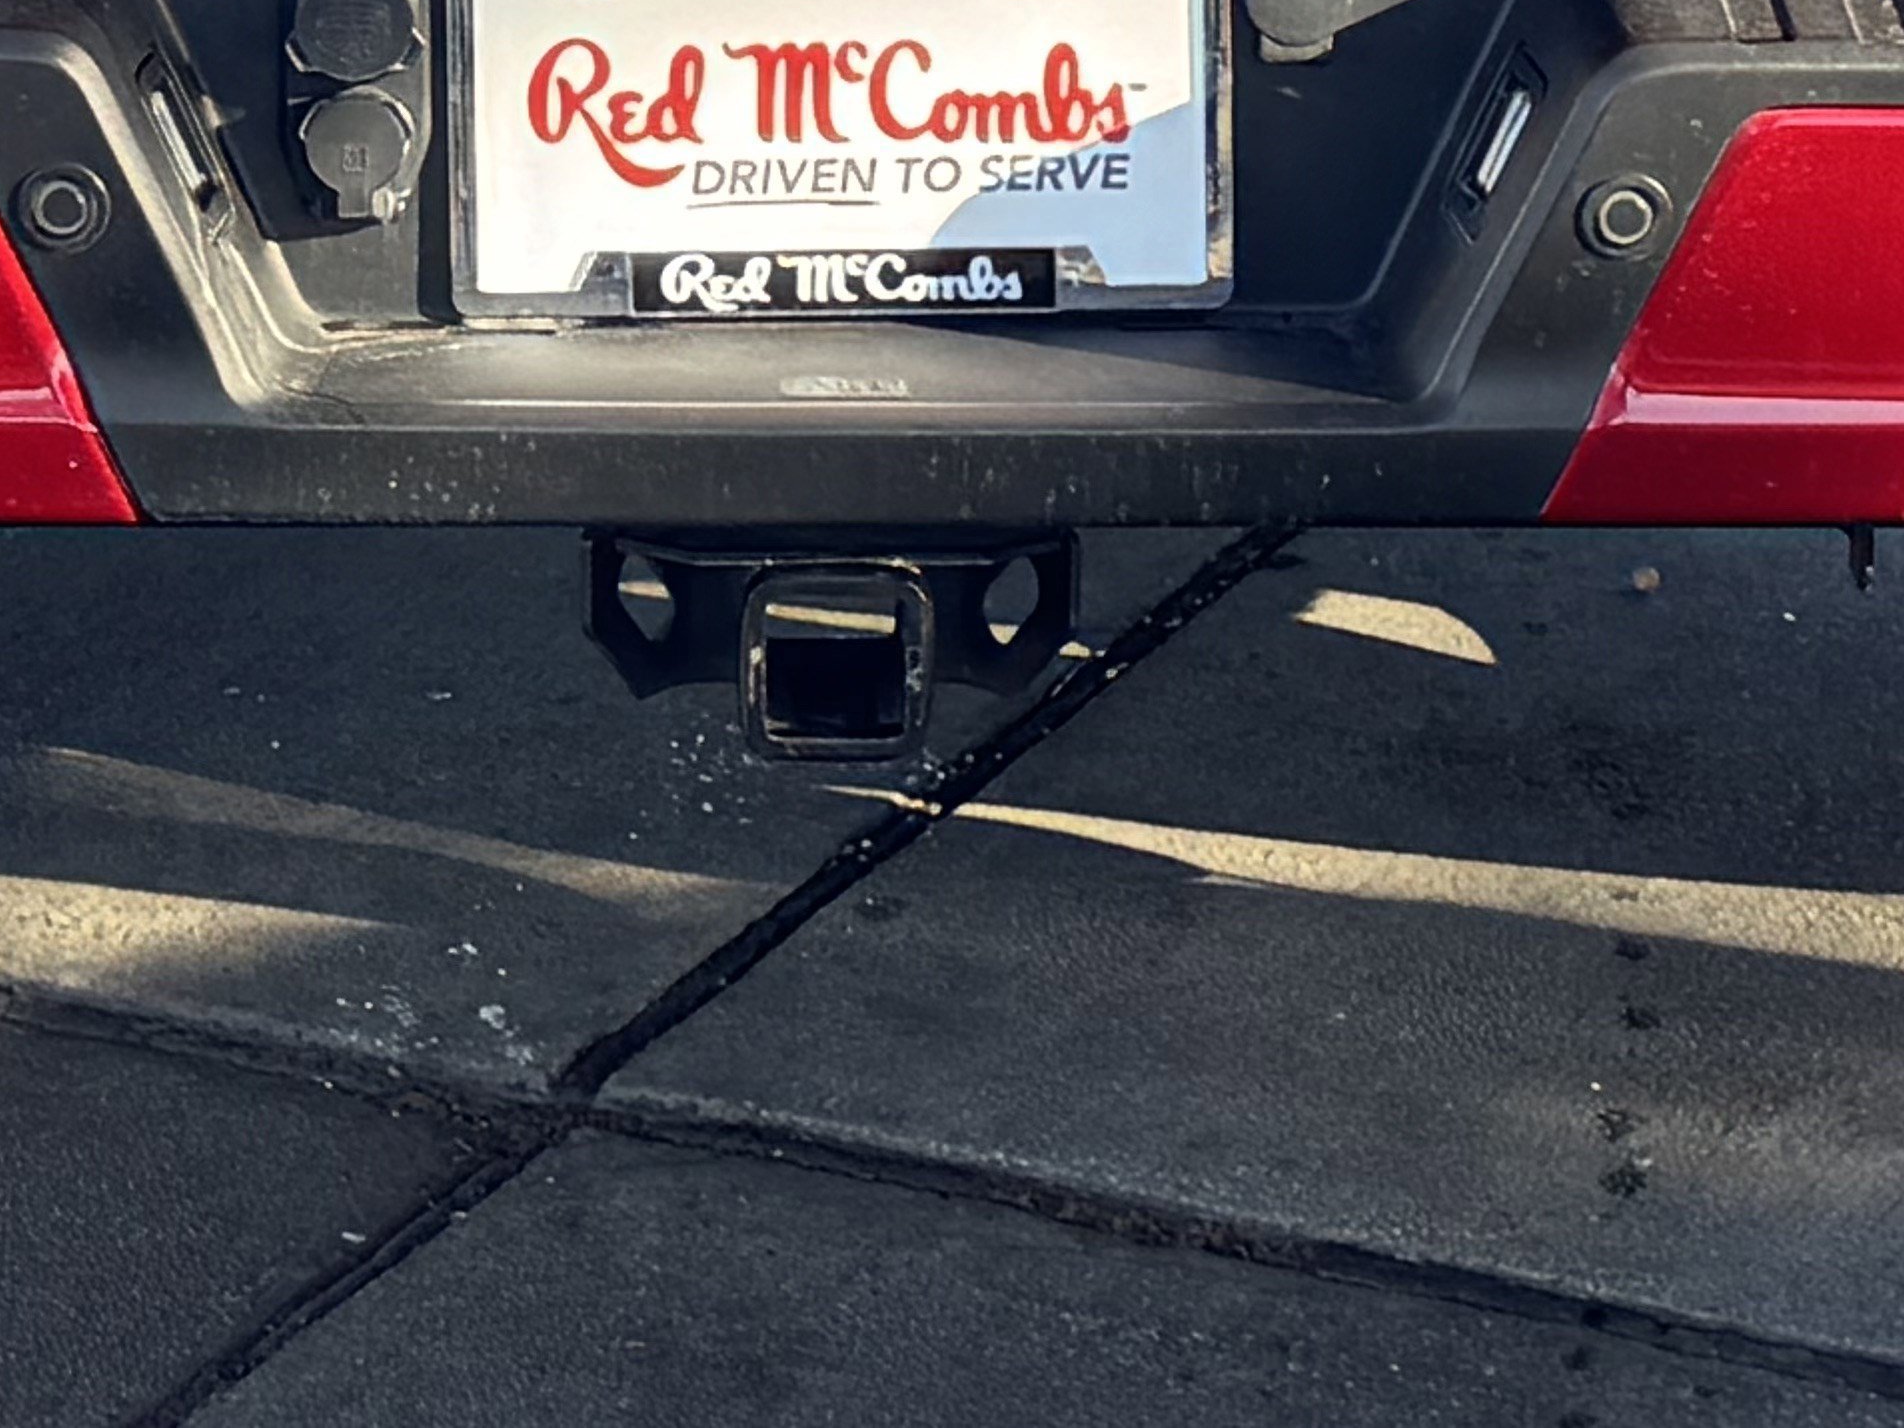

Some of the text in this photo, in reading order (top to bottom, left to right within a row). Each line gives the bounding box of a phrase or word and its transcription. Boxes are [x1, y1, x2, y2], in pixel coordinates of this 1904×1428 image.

[528, 38, 1131, 187] Red McCombs
[692, 152, 1131, 195] DRIVEN TO SERVE
[659, 253, 1024, 313] Red McCombs
